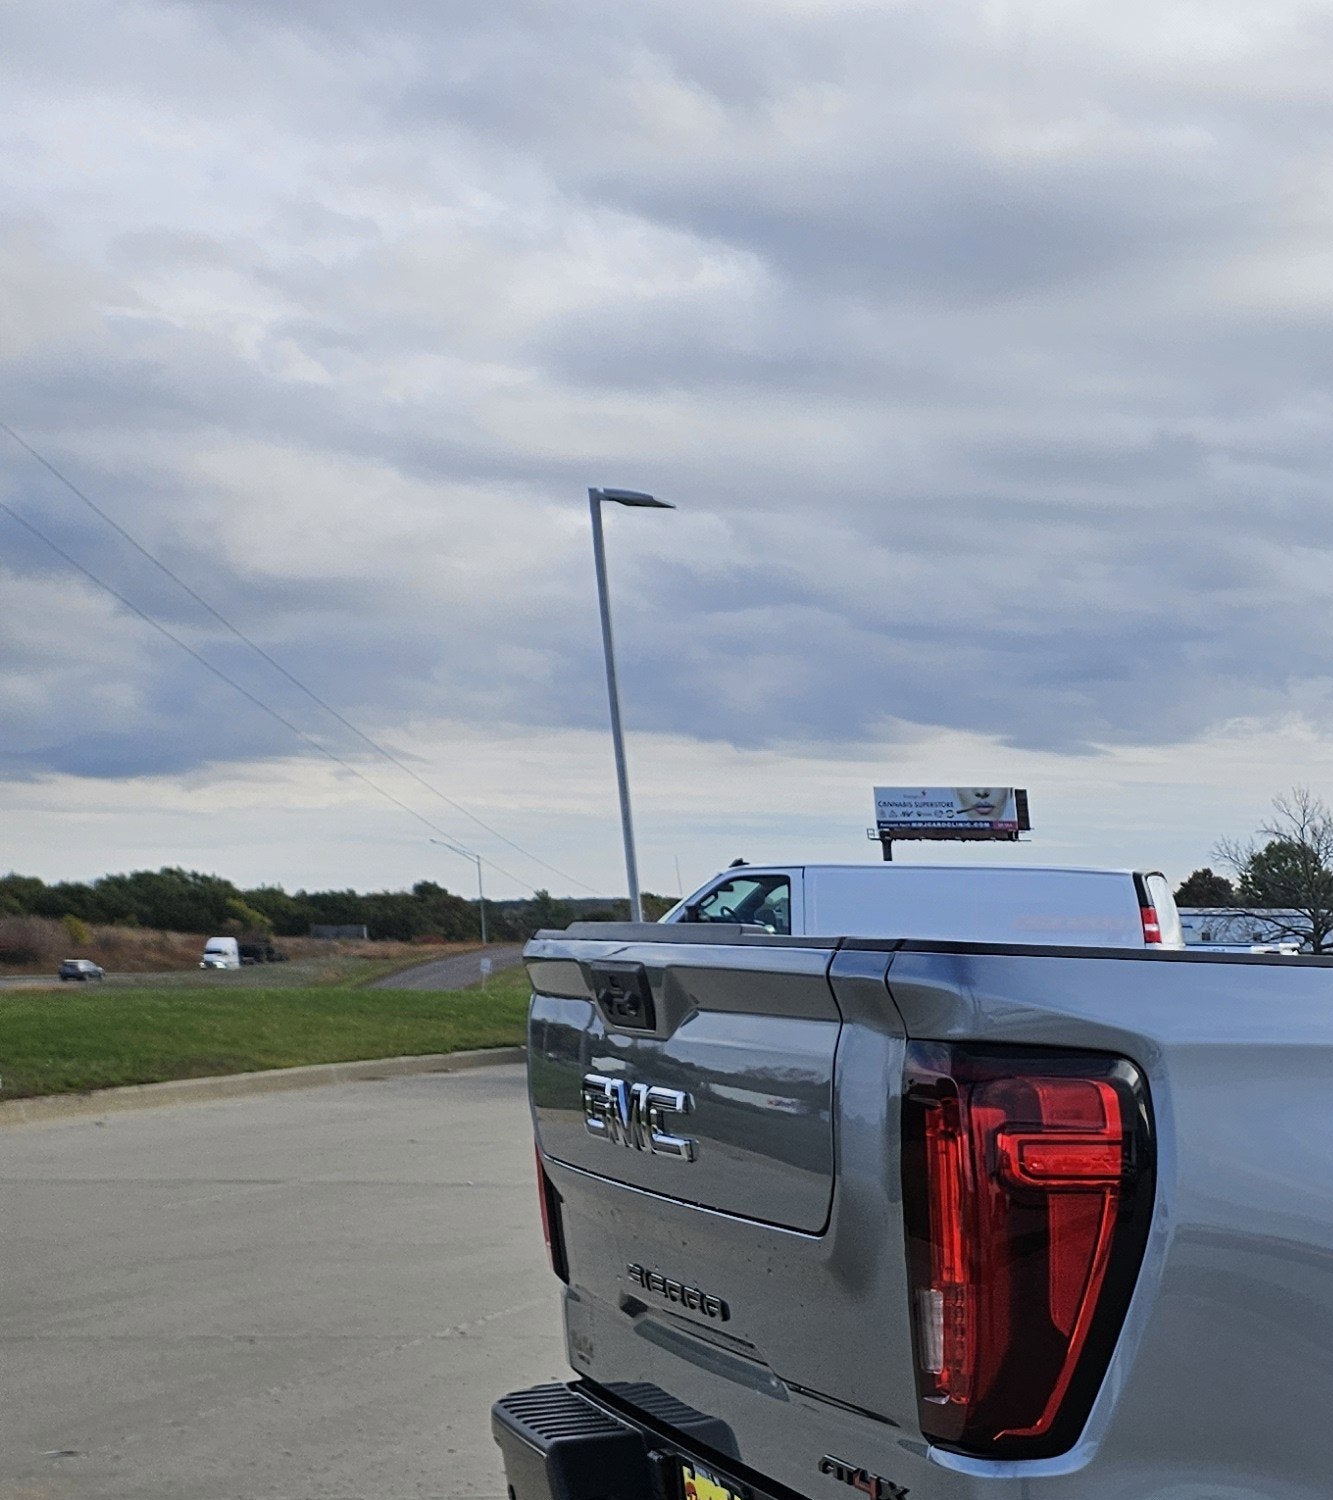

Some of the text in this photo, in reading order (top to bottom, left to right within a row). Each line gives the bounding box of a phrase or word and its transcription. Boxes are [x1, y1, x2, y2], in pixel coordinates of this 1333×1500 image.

[877, 800, 954, 808] CANNABIS SUPERSTORE
[582, 1073, 697, 1163] GMC
